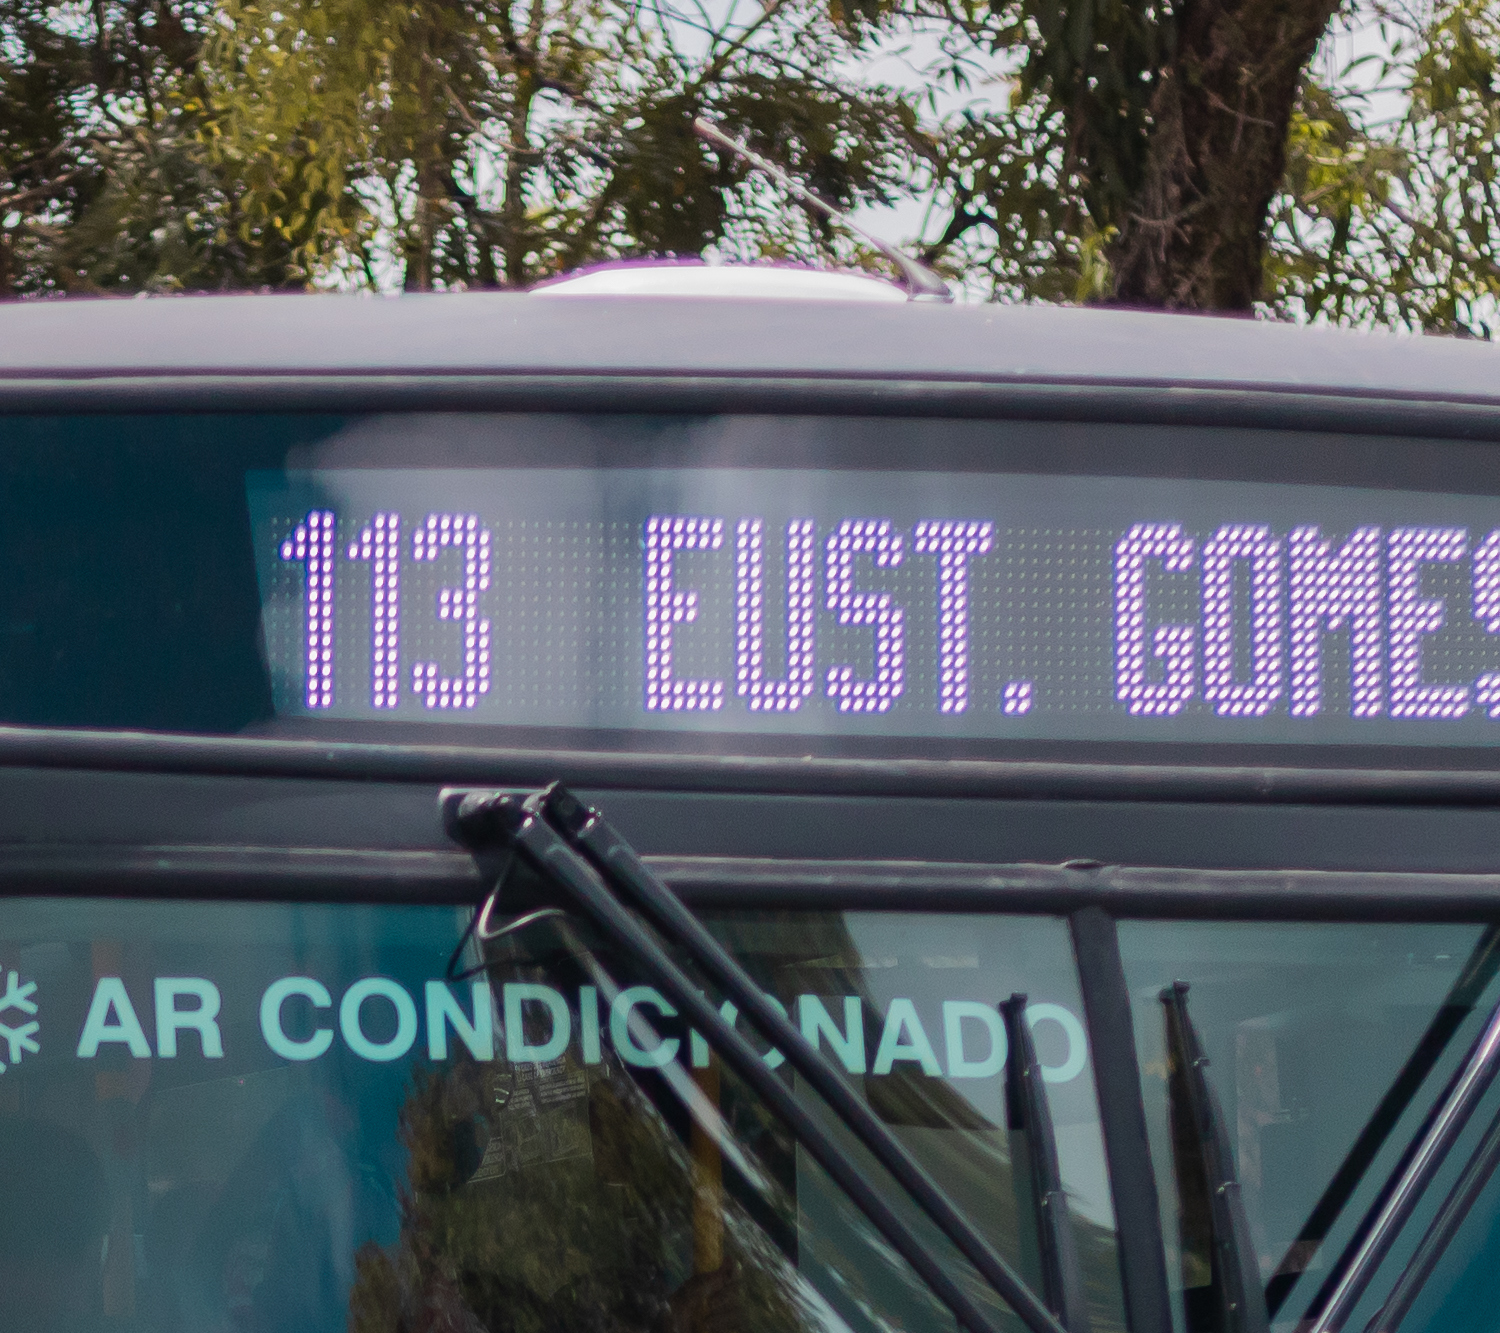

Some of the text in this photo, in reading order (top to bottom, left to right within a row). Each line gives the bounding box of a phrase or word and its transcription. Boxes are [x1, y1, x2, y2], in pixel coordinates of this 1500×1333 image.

[277, 510, 491, 712] 113
[642, 515, 1034, 715] EUST.
[75, 976, 224, 1058] AR
